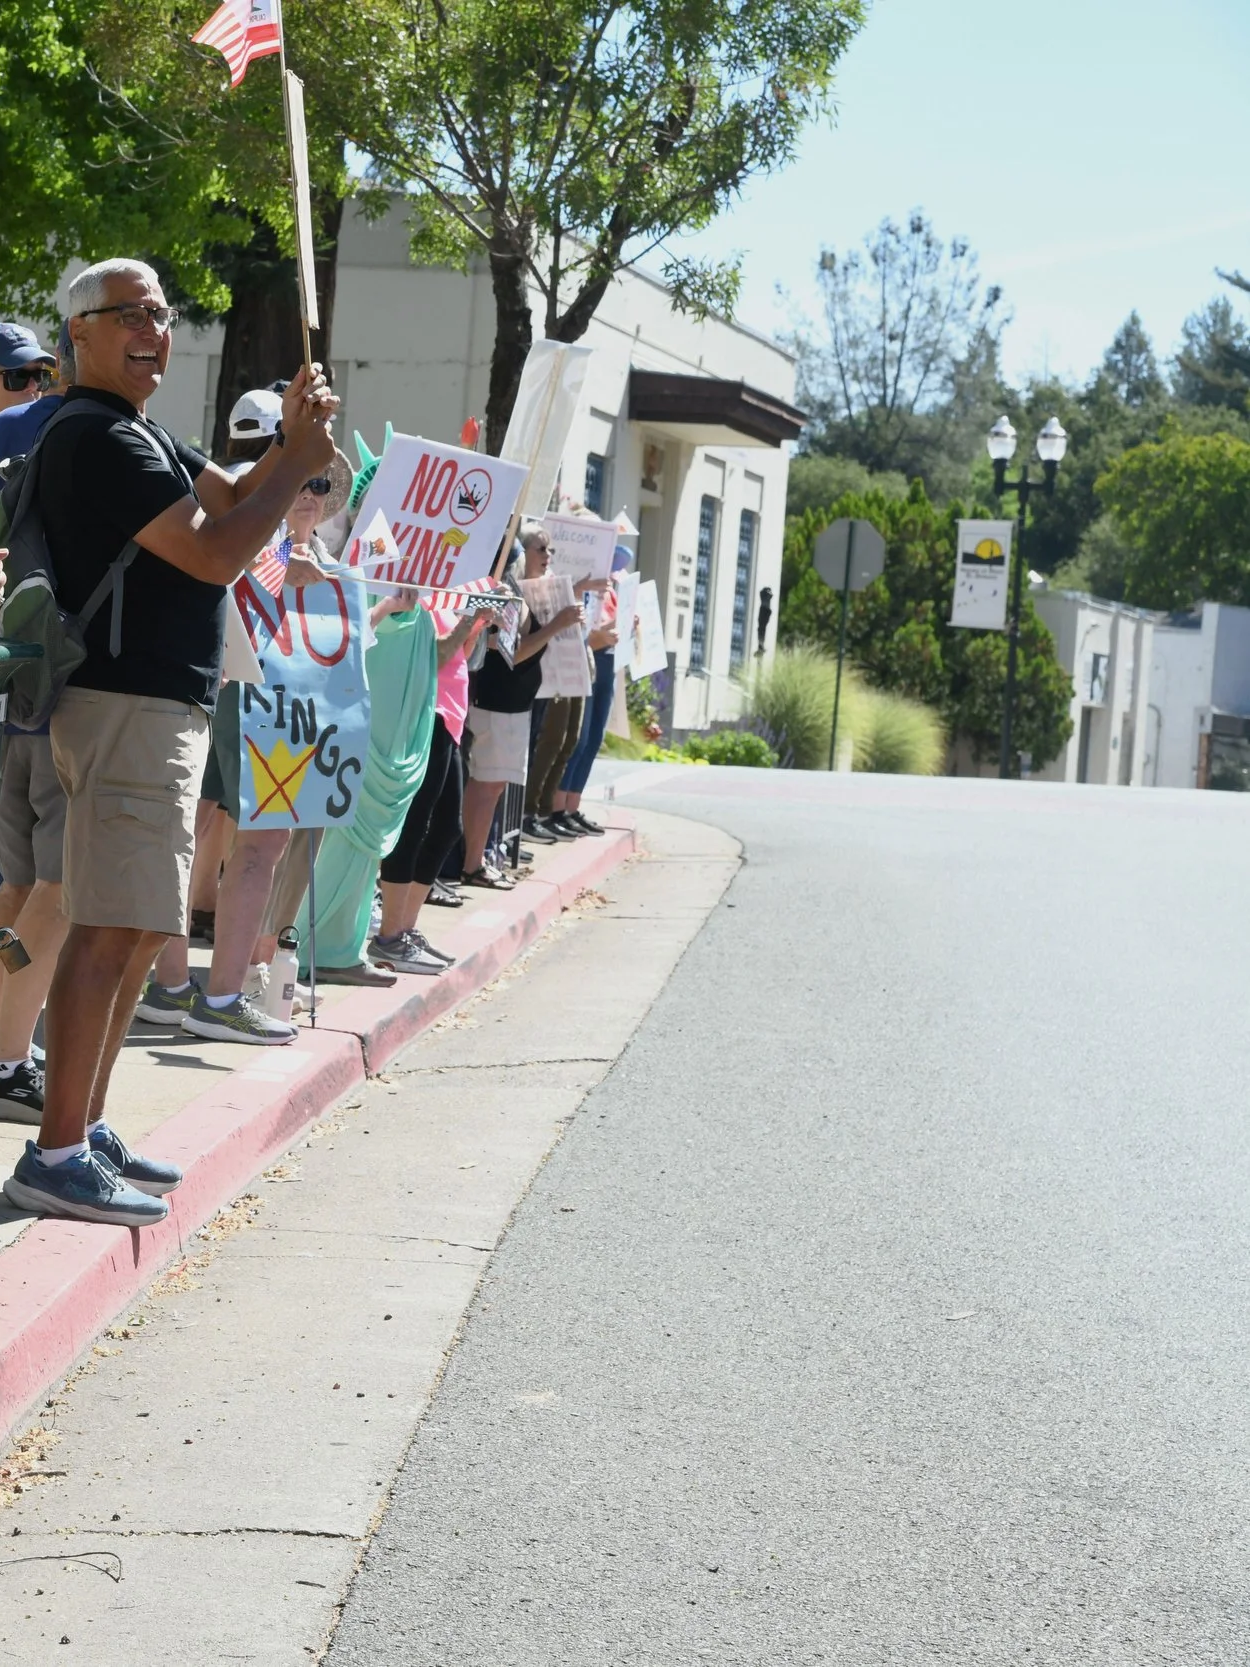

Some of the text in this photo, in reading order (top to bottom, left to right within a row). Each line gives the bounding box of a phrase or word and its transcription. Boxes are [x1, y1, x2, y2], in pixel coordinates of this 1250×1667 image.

[401, 453, 458, 518] NO
[373, 522, 463, 589] KING
[235, 574, 351, 668] NO
